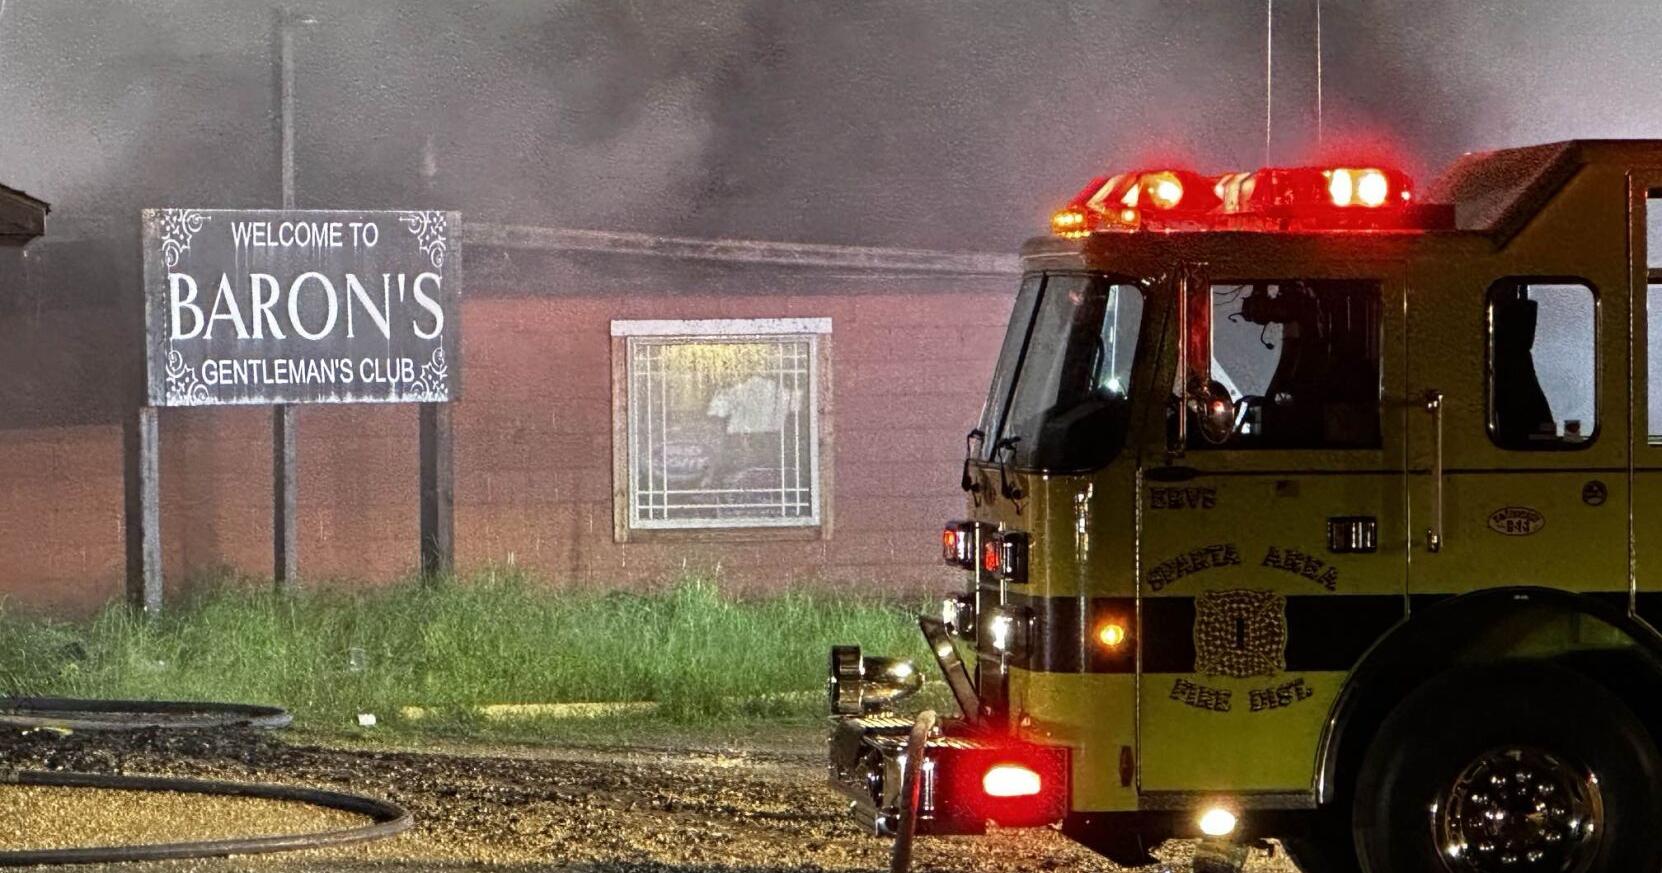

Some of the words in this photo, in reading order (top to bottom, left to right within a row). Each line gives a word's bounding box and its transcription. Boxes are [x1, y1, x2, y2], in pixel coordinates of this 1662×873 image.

[231, 221, 343, 248] WELCOME
[349, 221, 379, 247] TO
[167, 271, 444, 341] BARON'S
[201, 358, 353, 385] GENTLEMAN'S
[359, 357, 415, 384] CLUB
[1147, 544, 1241, 592] SPARTA
[1262, 546, 1338, 592] AREA
[1169, 678, 1232, 712] FIRE
